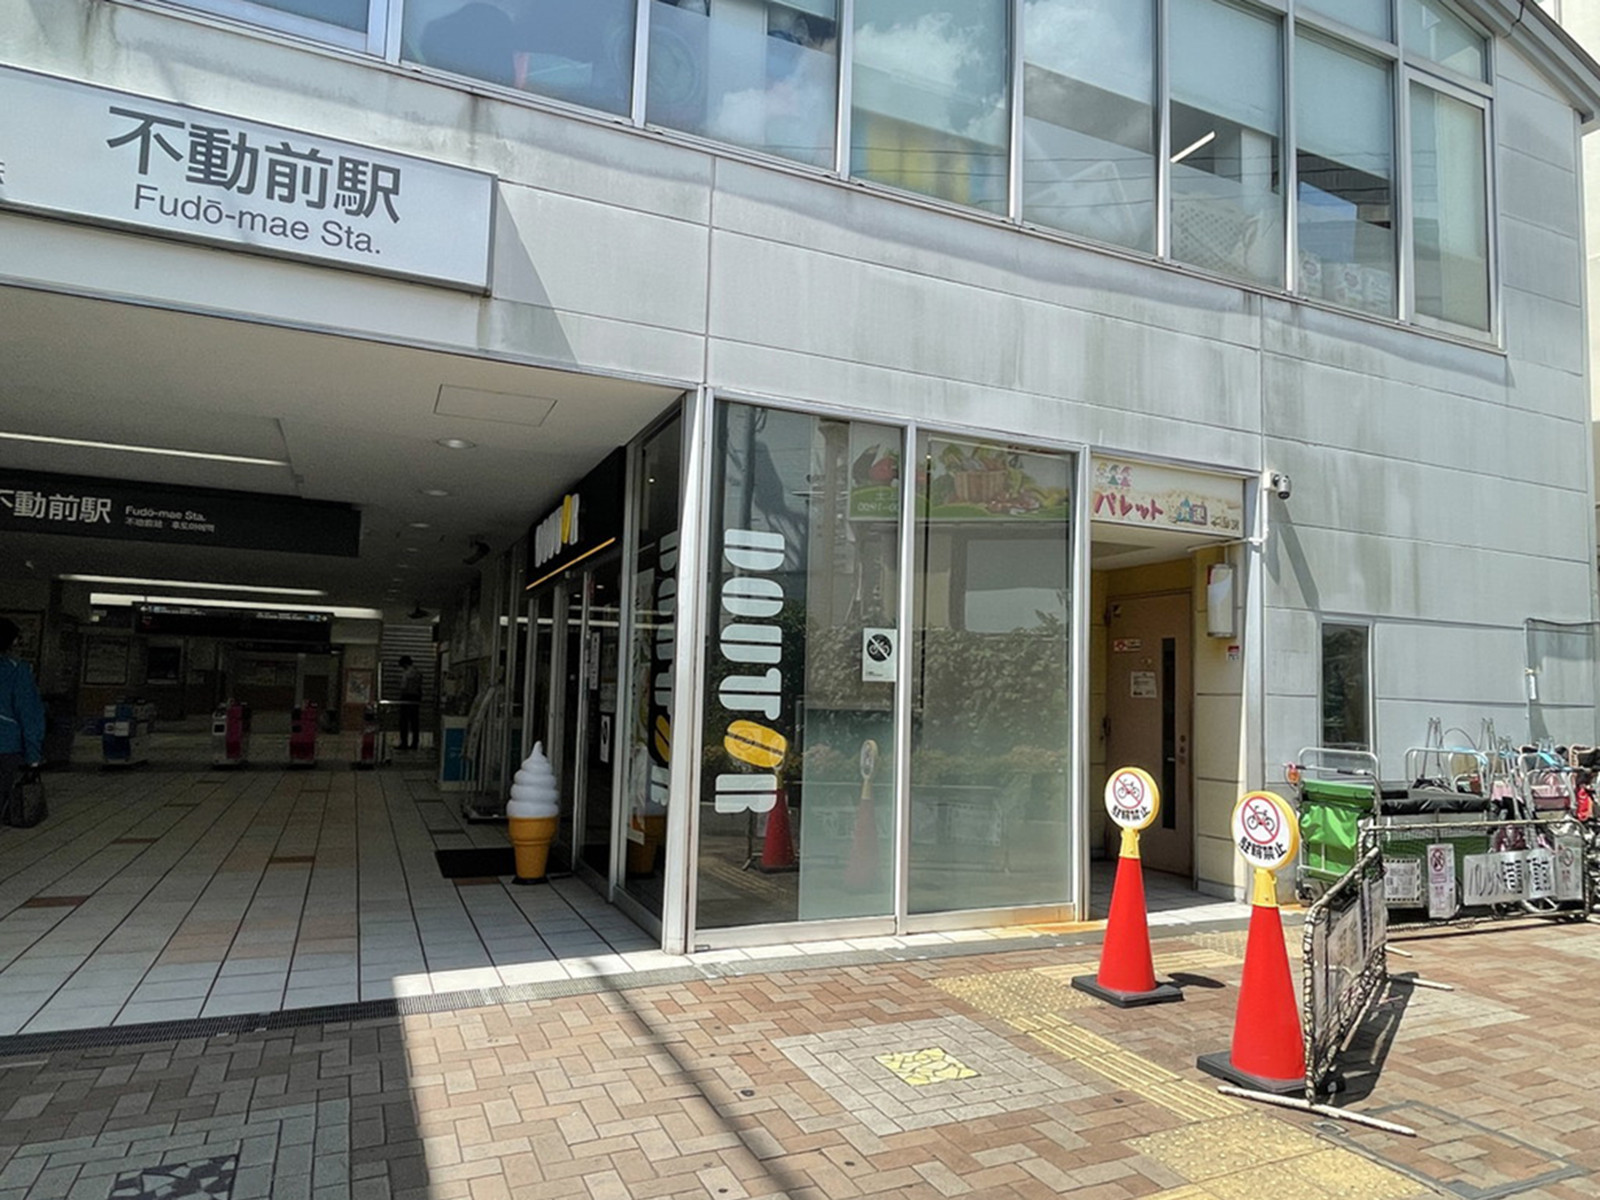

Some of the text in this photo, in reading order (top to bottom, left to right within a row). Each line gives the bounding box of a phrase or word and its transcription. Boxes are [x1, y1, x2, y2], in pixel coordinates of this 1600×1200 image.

[107, 105, 401, 223] 不動前駅
[134, 184, 381, 254] Fudō-mae Sta.
[715, 528, 788, 814] DOUTOR
[1238, 836, 1288, 860] 駐輪禁止
